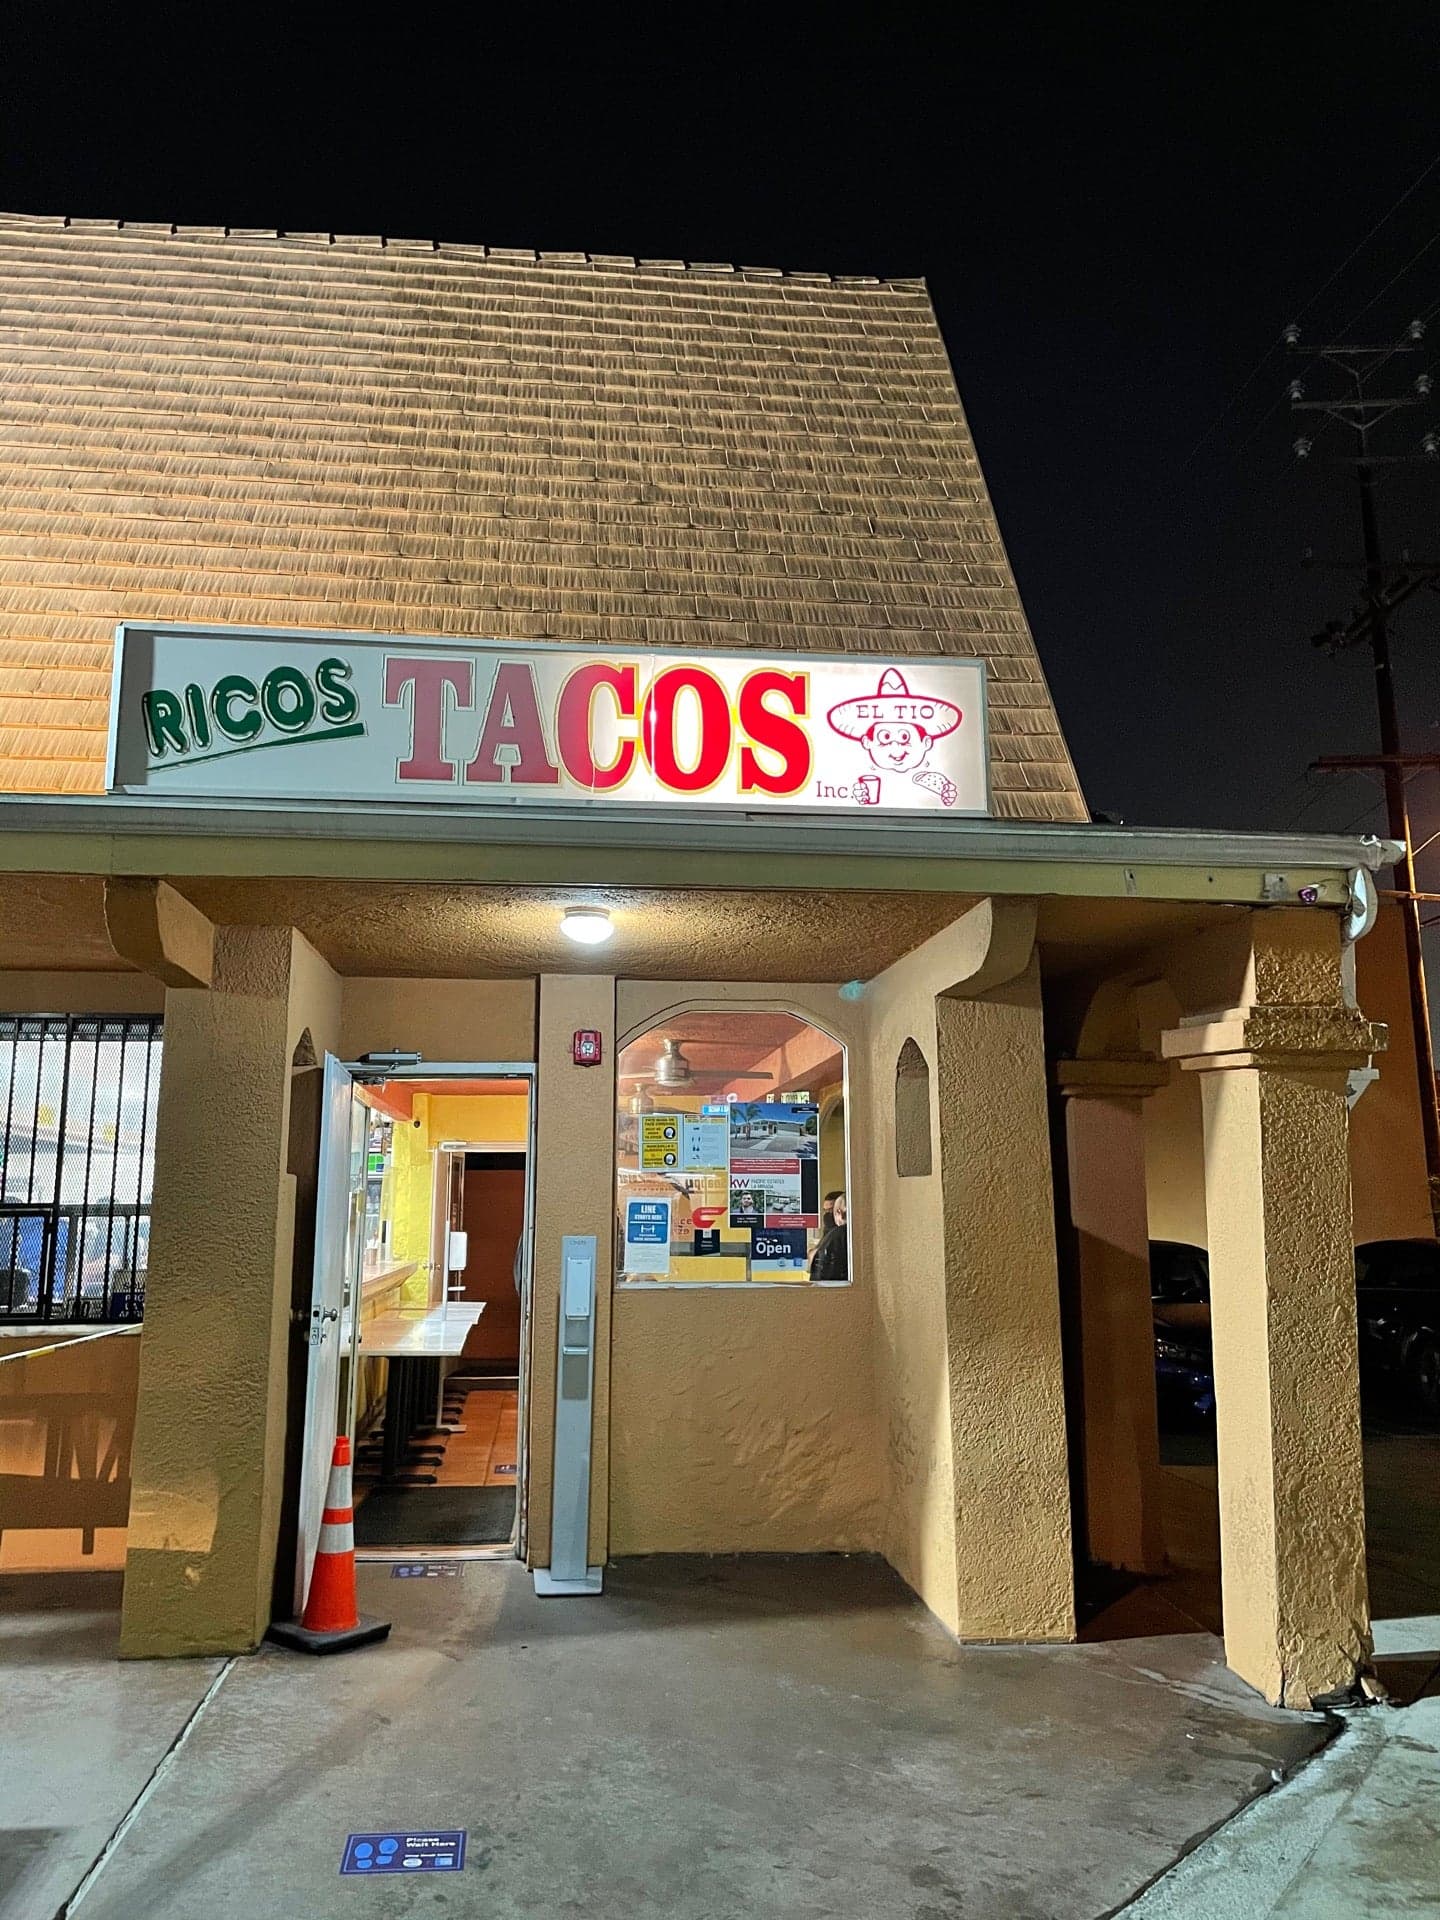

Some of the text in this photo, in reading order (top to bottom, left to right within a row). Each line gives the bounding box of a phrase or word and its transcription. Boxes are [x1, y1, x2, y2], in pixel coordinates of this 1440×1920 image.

[142, 657, 360, 759] RICOS
[856, 704, 936, 720] EL TIO
[382, 653, 814, 799] TACOS
[815, 780, 854, 800] Inc.
[730, 1174, 750, 1189] kw
[640, 1204, 657, 1214] LINE
[755, 1241, 792, 1257] Open
